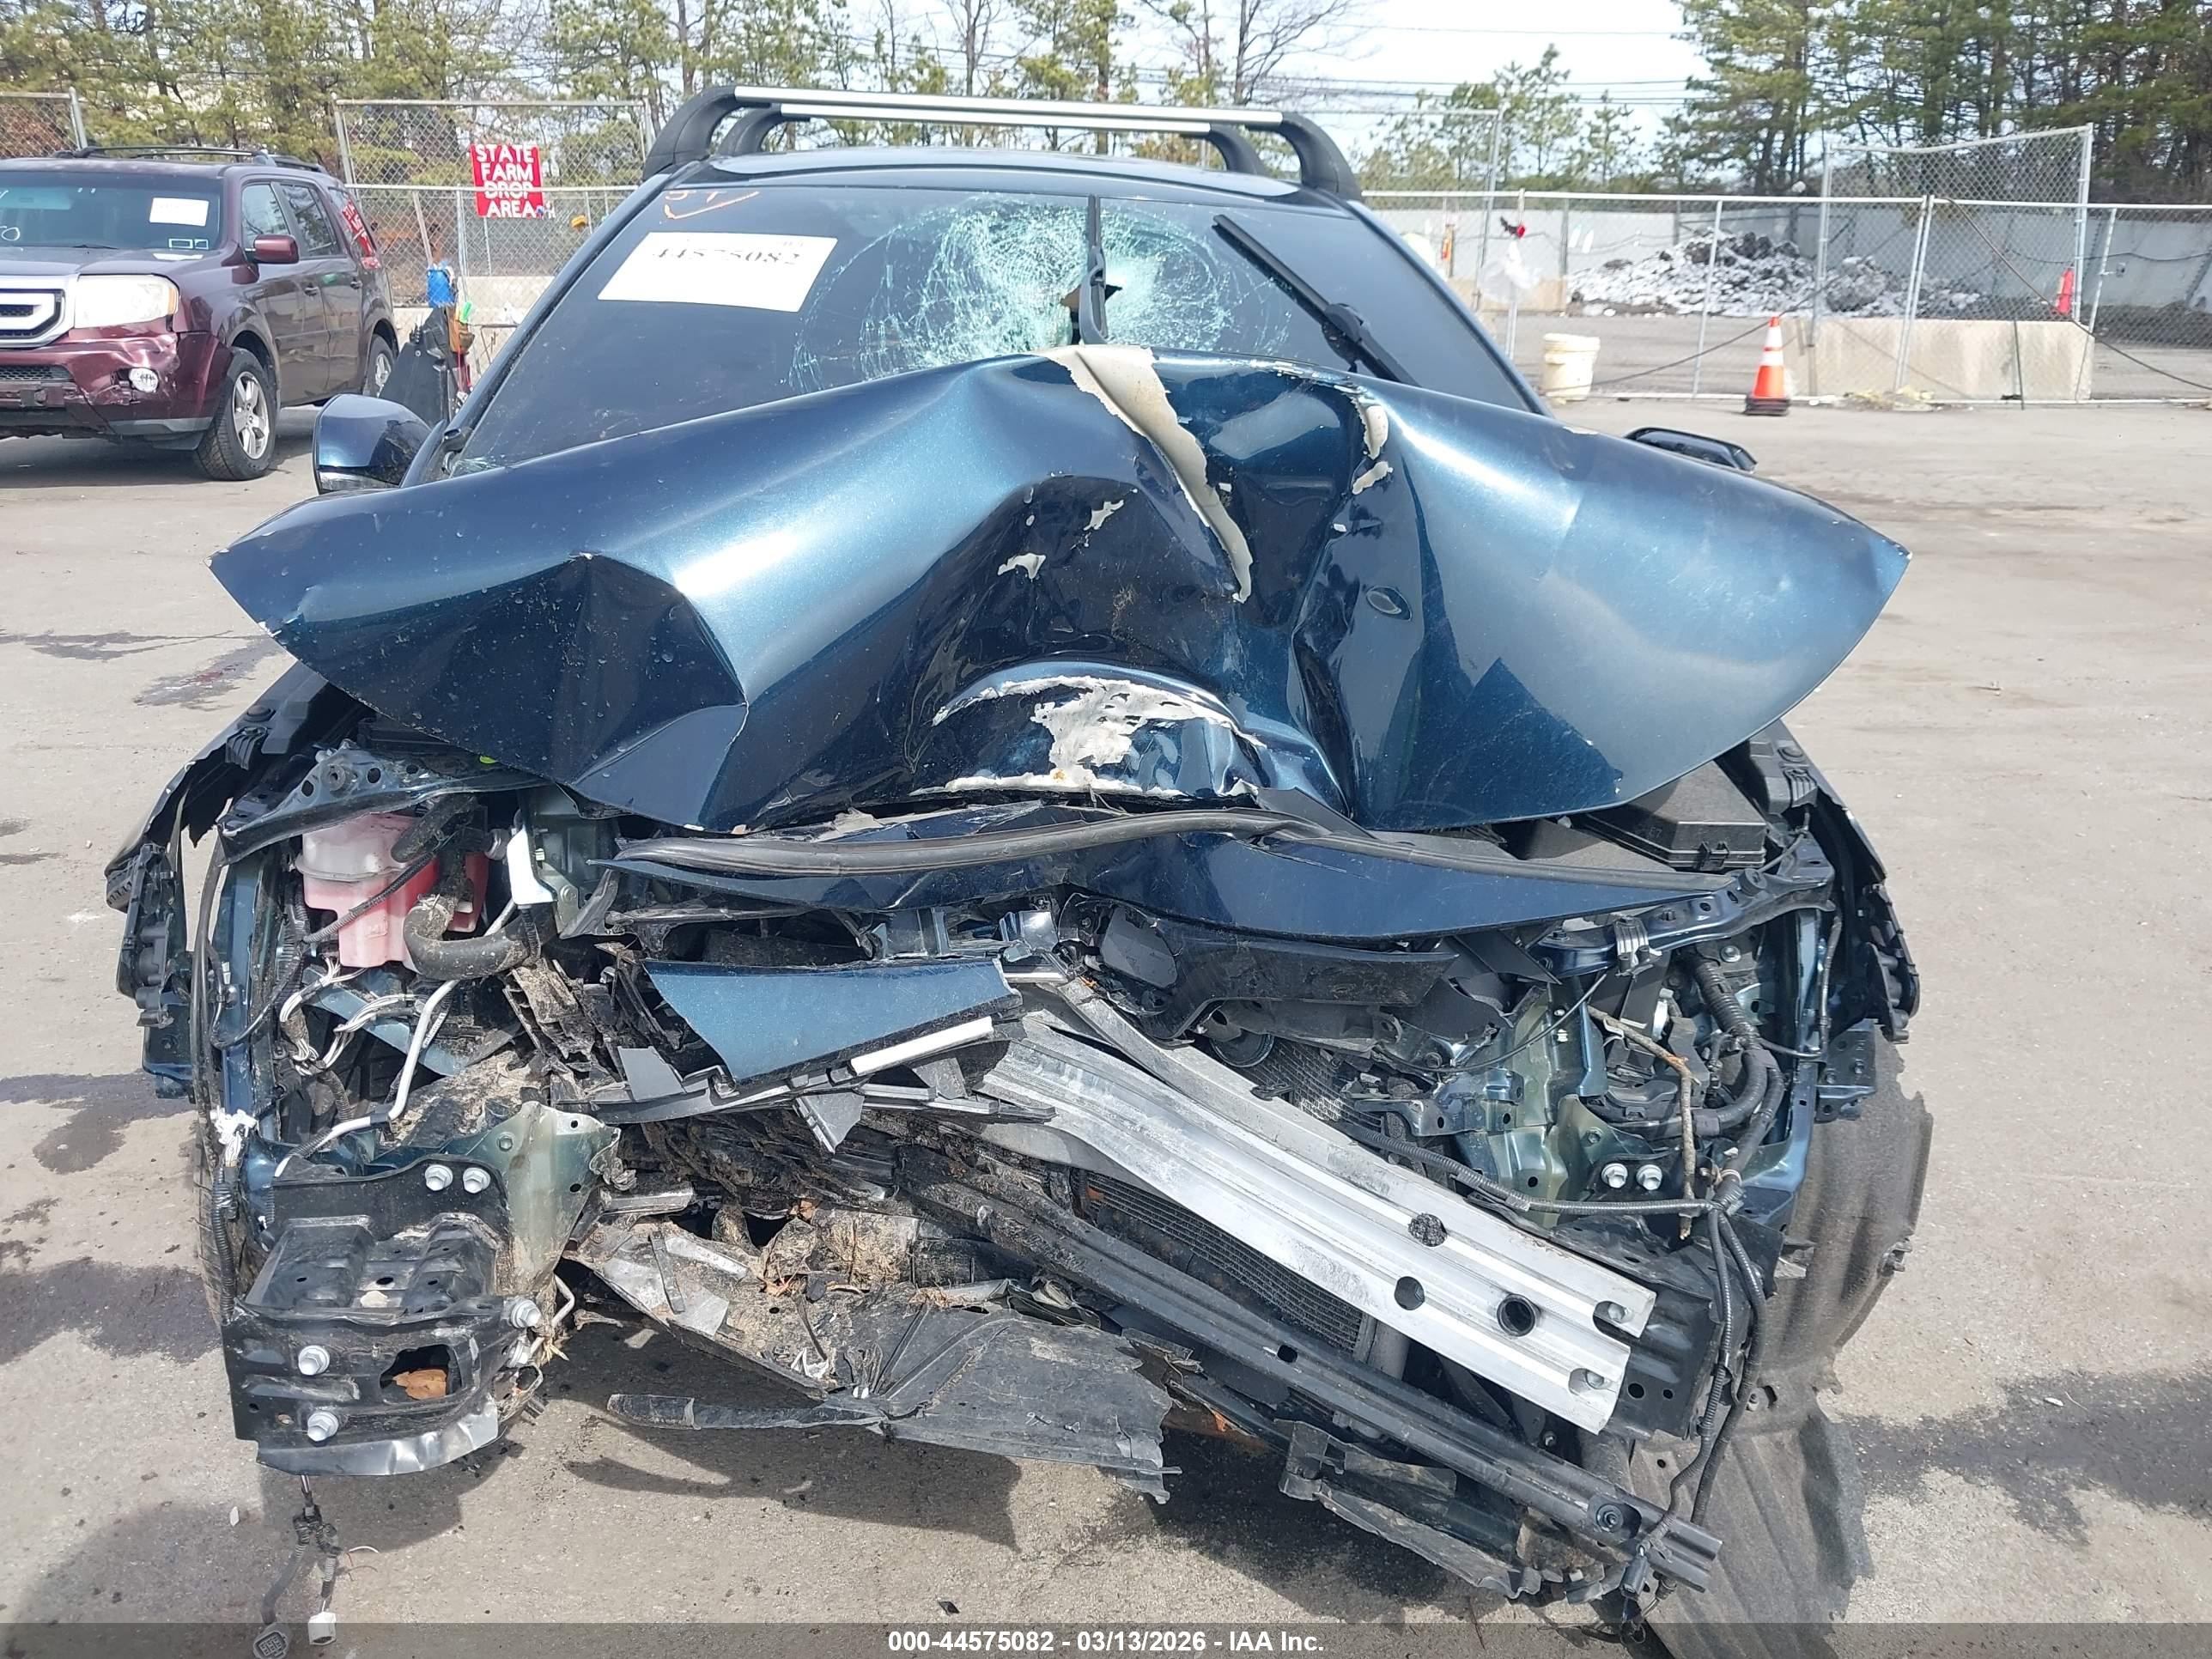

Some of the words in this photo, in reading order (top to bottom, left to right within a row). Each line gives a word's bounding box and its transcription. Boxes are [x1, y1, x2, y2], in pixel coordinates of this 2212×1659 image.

[476, 143, 534, 163] STATE
[481, 162, 534, 182] FARM
[483, 181, 533, 200] DROP
[487, 200, 537, 218] AREA
